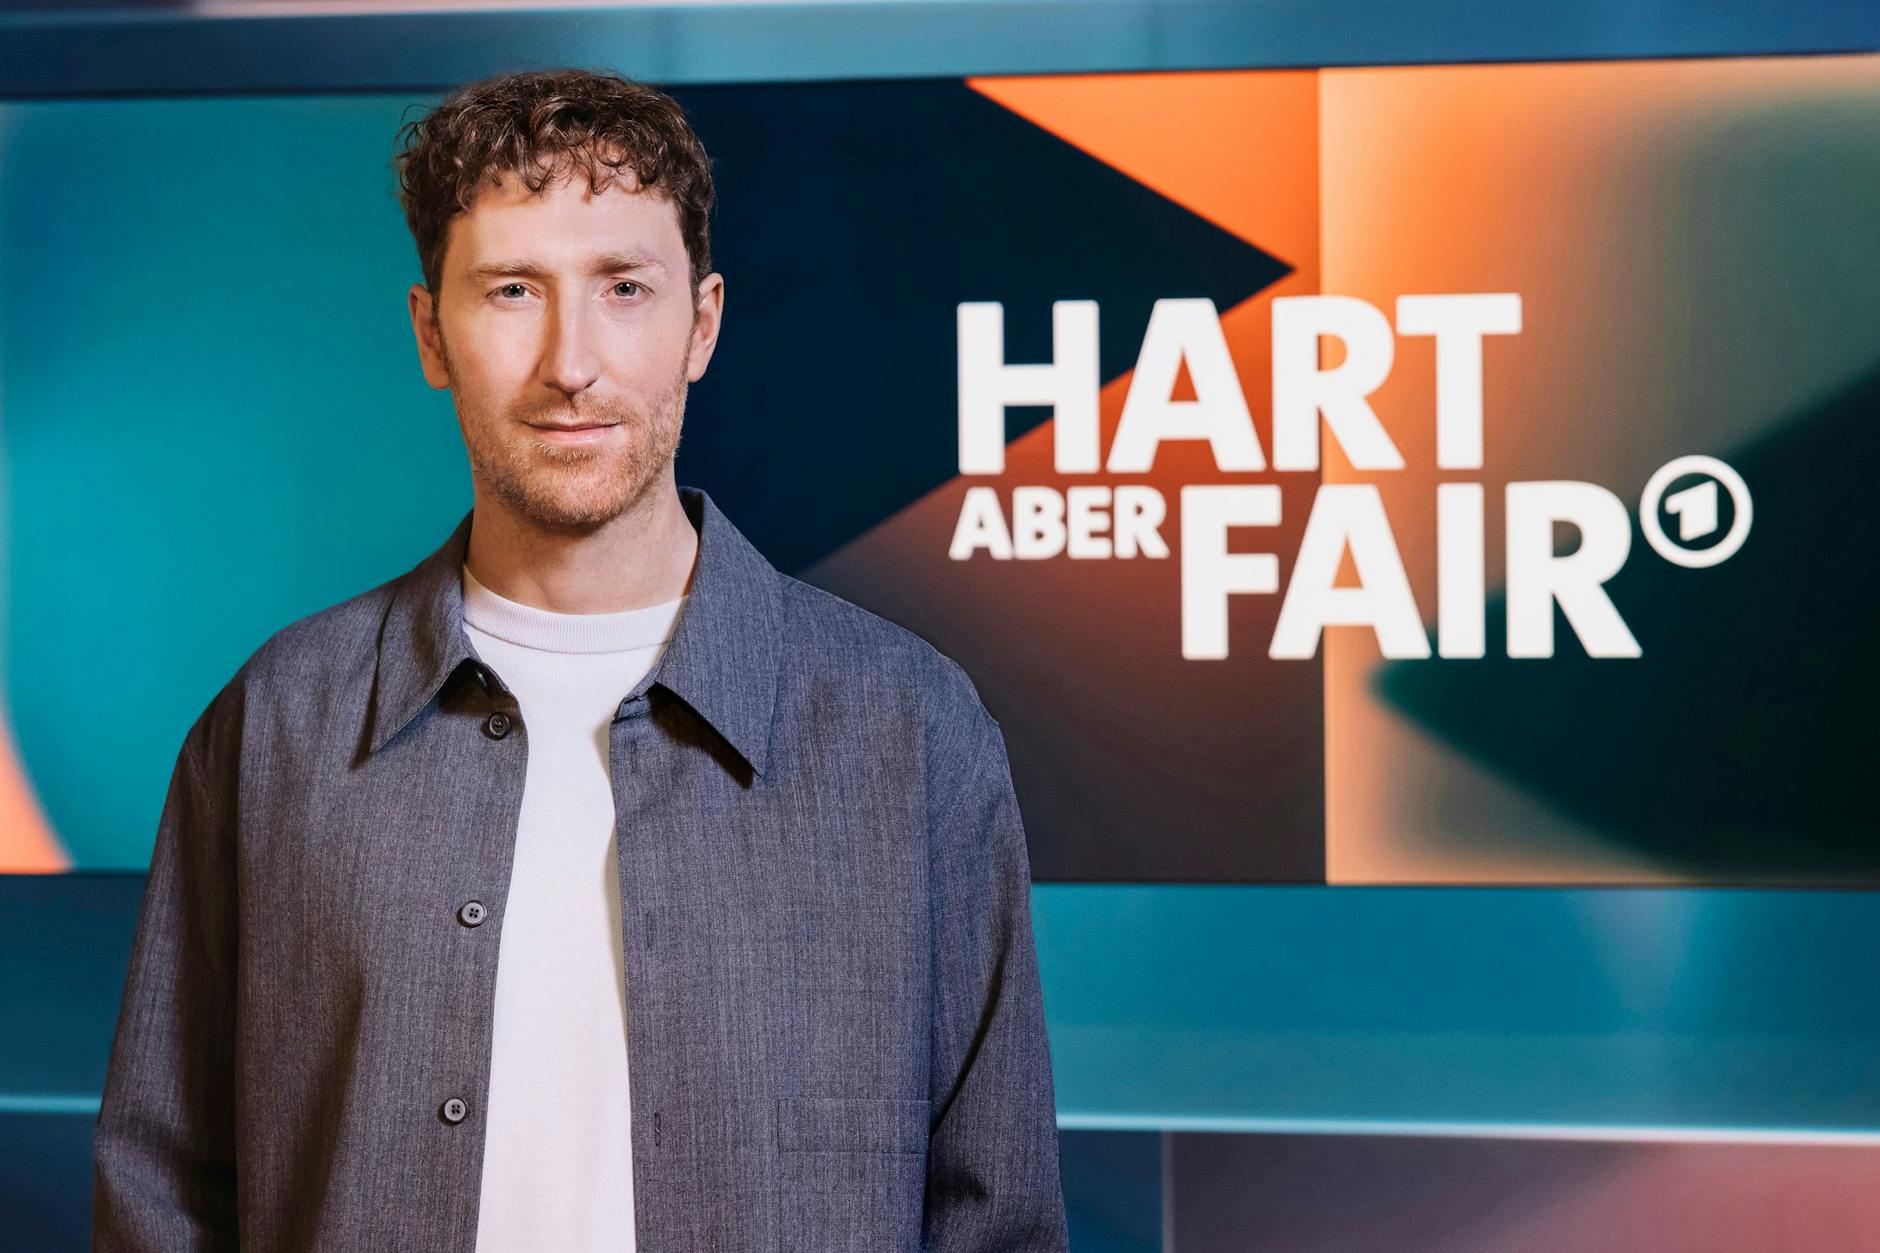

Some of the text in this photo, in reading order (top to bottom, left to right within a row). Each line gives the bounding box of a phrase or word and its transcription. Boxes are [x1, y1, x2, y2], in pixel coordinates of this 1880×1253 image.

[956, 292, 1523, 475] HART
[948, 480, 1642, 660] ABER FAIR
